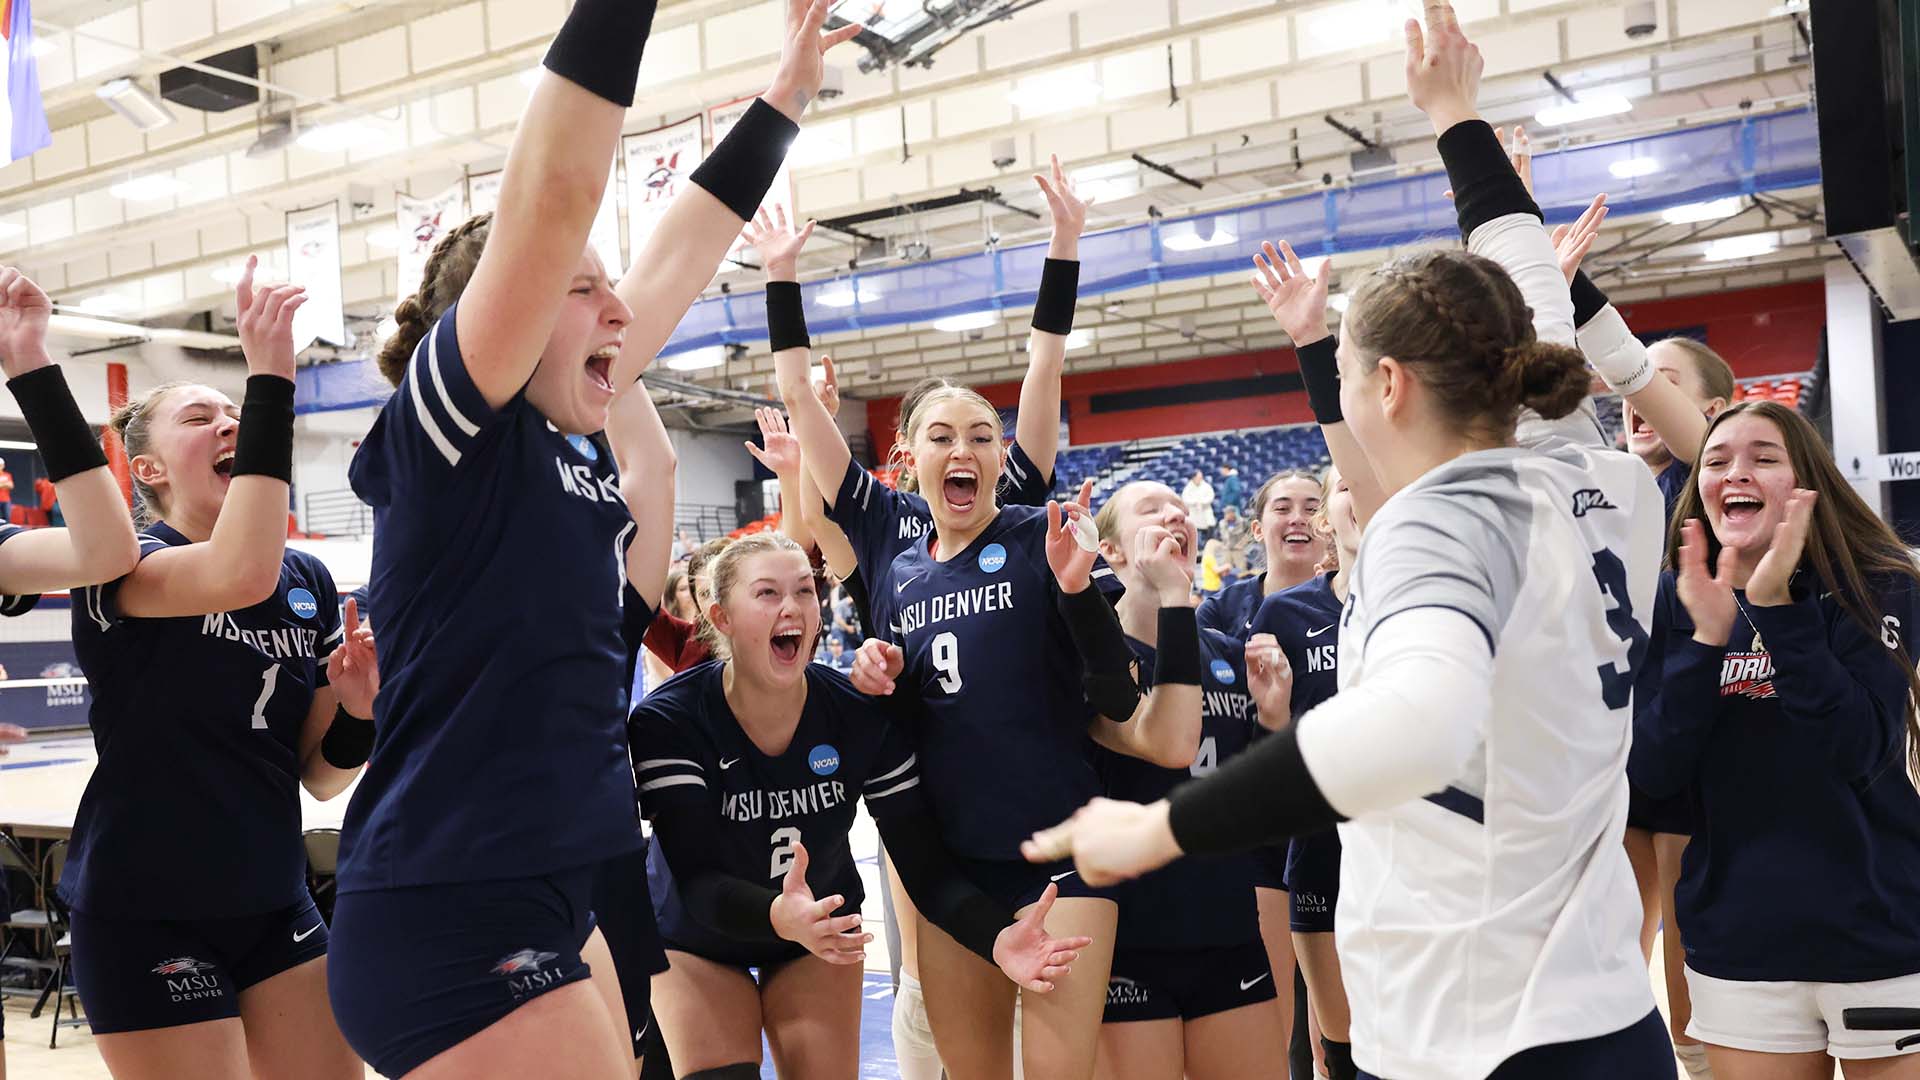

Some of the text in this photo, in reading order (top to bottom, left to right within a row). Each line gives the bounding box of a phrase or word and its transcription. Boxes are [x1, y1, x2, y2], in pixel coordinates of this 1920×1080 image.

[293, 602, 317, 611] NCAA
[899, 581, 1014, 638] MSU DENVER
[1592, 547, 1650, 710] 3
[931, 631, 963, 695] 9
[47, 683, 83, 697] MSU
[251, 662, 281, 729] 1
[46, 696, 84, 707] DENVER
[813, 757, 839, 769] NCAA
[1190, 736, 1217, 777] 4
[721, 780, 846, 822] MSU DENVER
[770, 826, 801, 879] 2
[1296, 894, 1326, 905] MSU
[1296, 905, 1328, 913] DENVER
[167, 975, 218, 992] MSU
[171, 989, 223, 1002] DENVER
